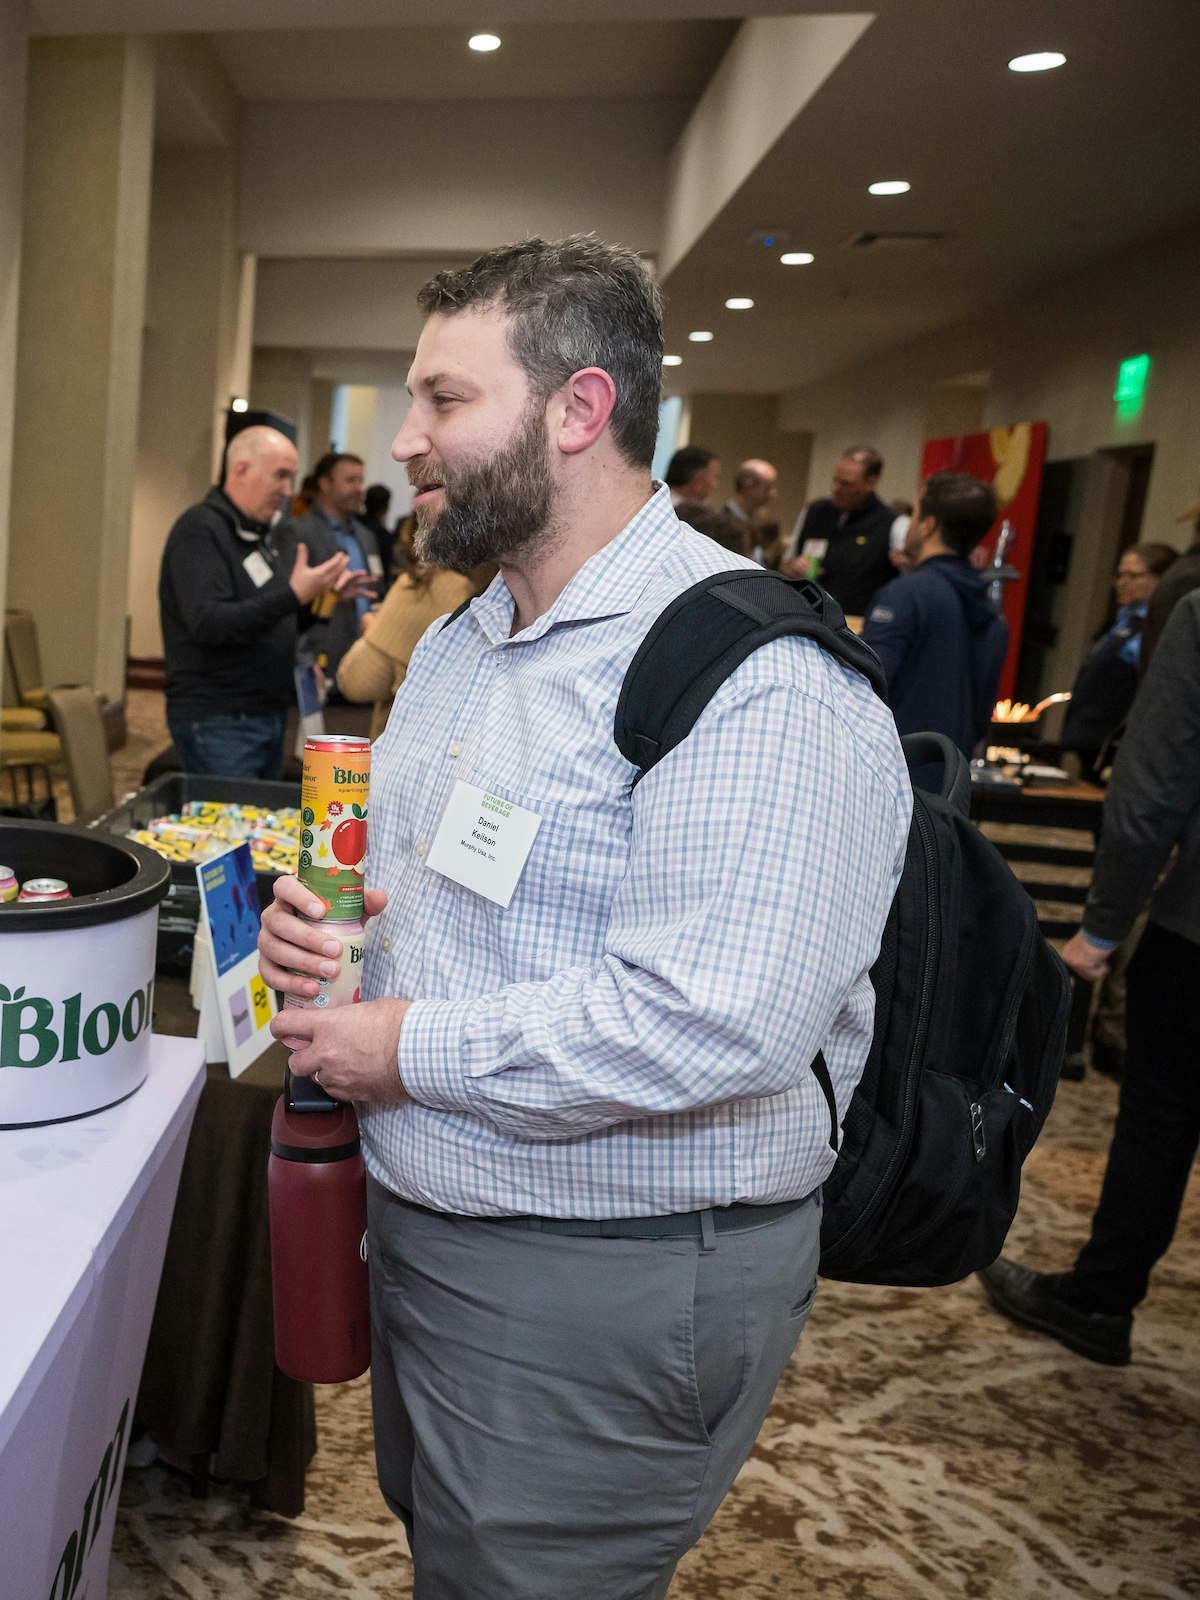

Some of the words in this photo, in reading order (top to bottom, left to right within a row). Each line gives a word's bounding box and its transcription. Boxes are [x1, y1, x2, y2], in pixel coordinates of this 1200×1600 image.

[481, 800, 511, 818] BEVERAGE
[483, 793, 506, 808] FUTURE
[504, 803, 514, 812] OF
[477, 816, 500, 832] Daniel
[460, 839, 478, 853] Murphy
[471, 829, 496, 847] Keilson
